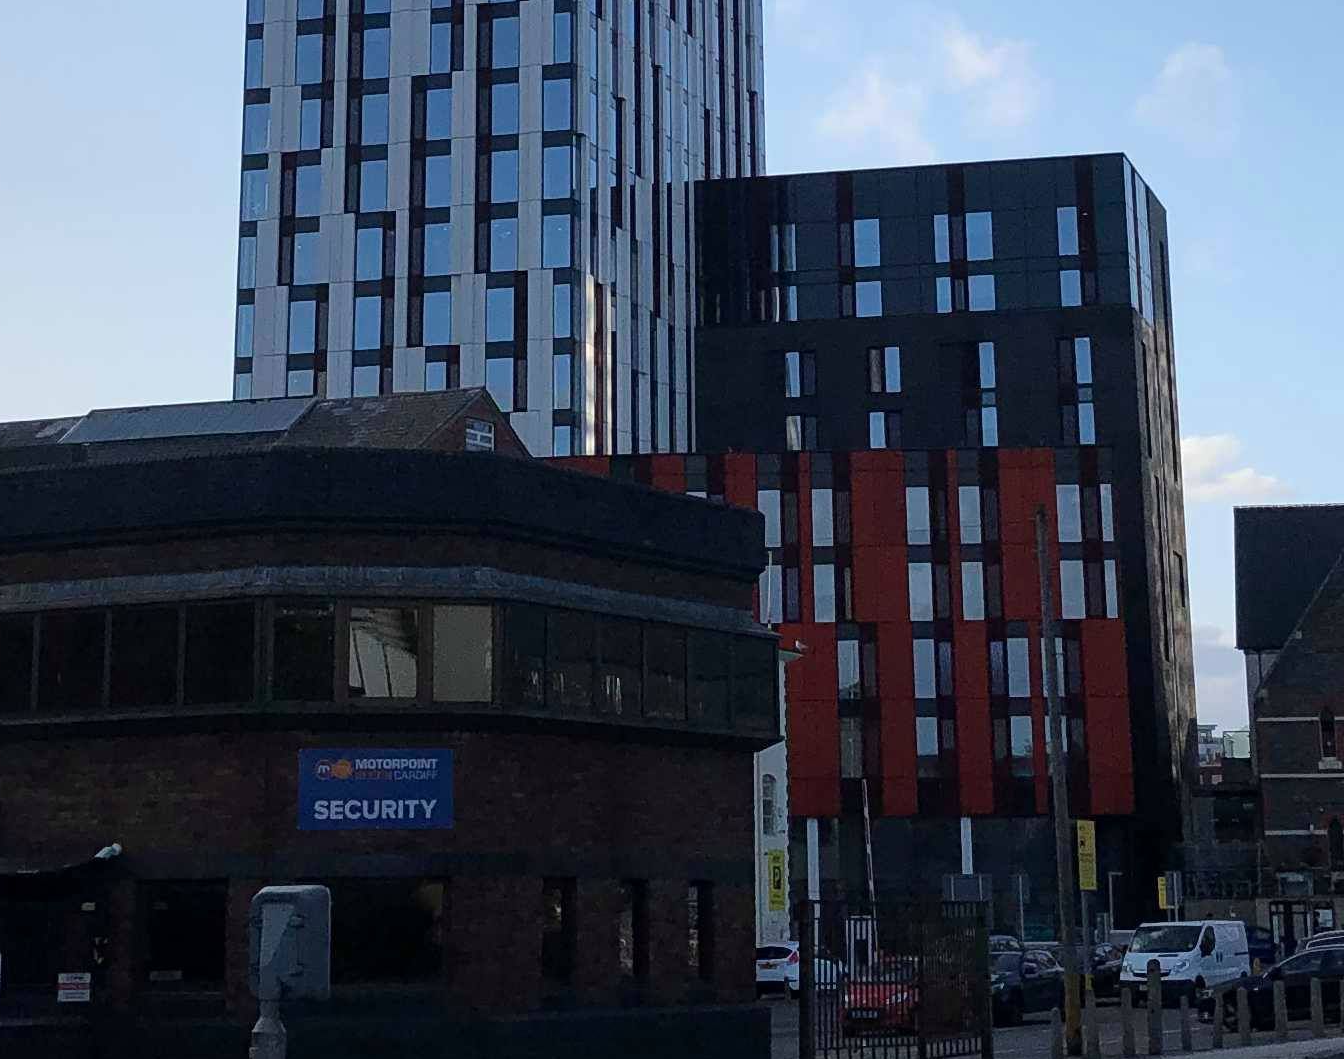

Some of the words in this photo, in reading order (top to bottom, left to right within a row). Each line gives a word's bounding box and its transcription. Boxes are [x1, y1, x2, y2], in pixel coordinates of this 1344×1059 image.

[355, 758, 439, 770] MOTORPOINT
[393, 770, 439, 781] CARDIFF
[313, 799, 438, 821] SECURITY
